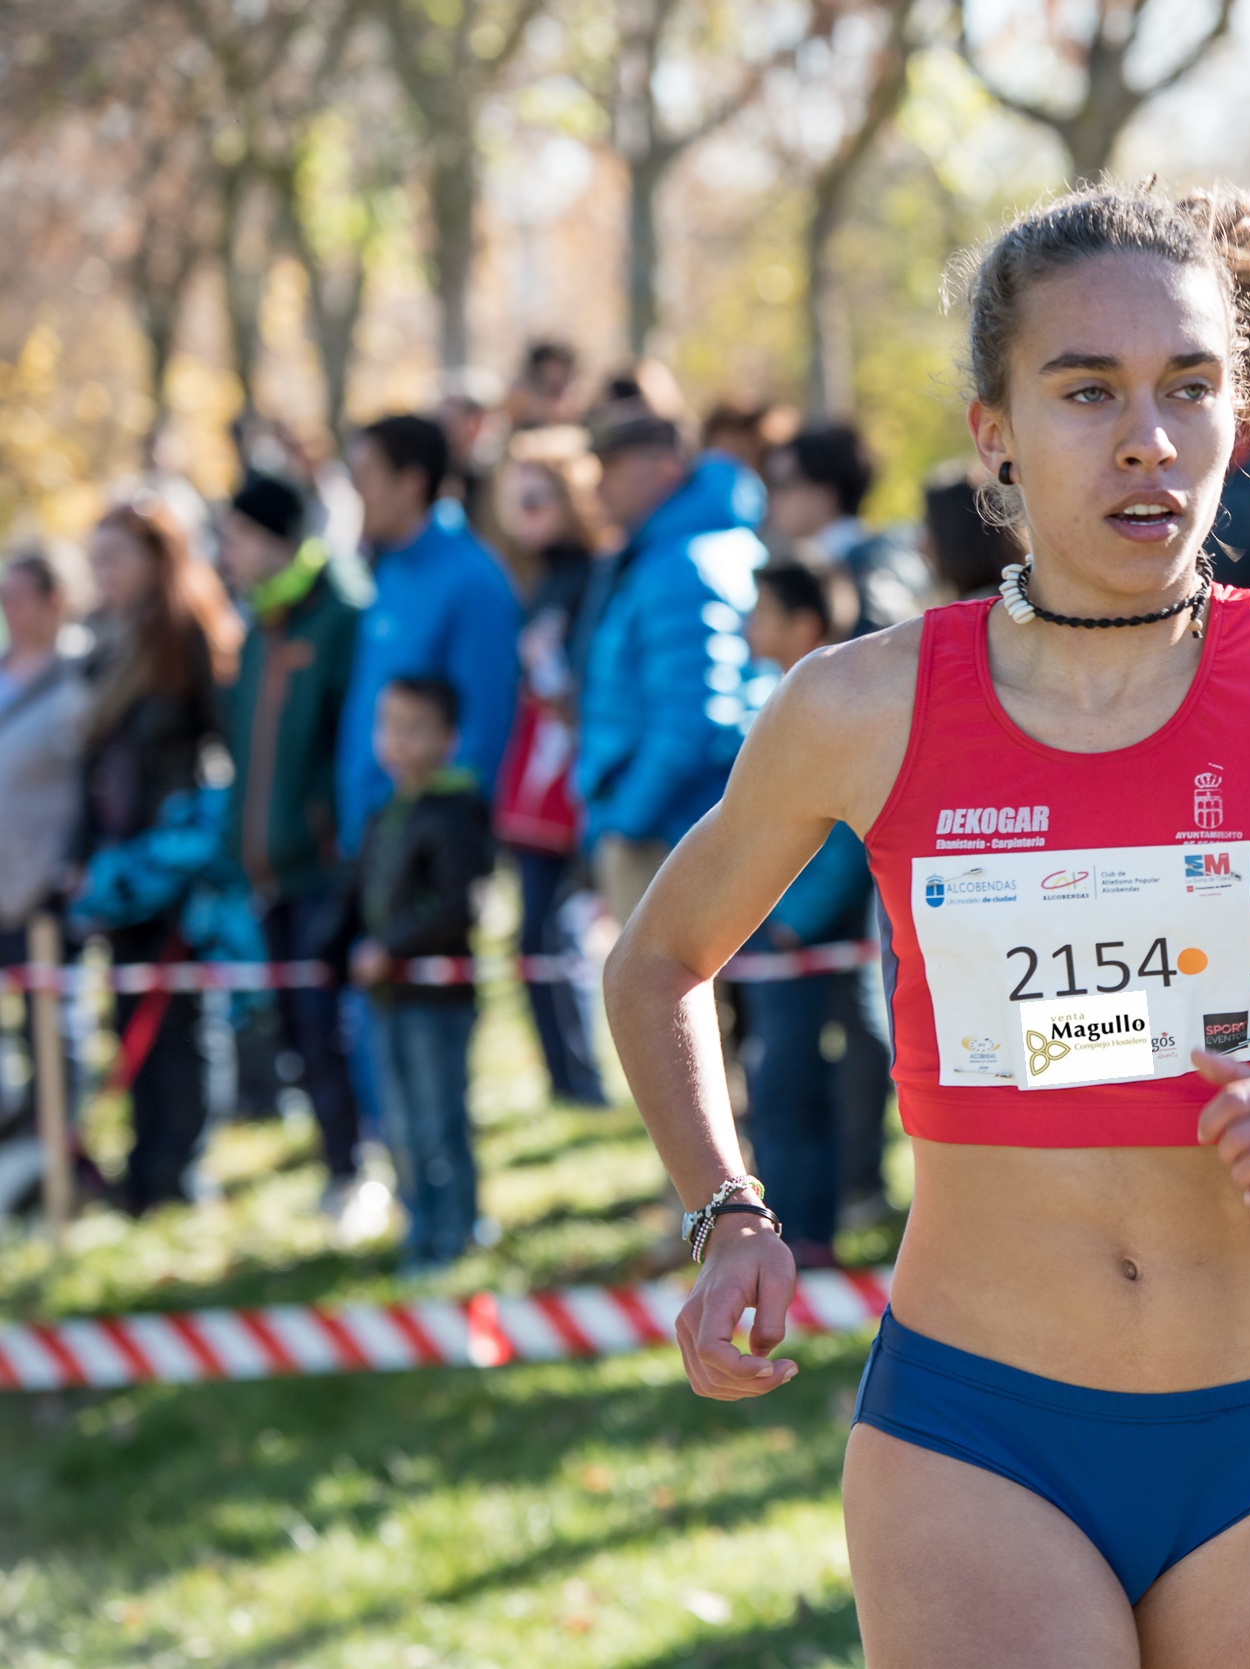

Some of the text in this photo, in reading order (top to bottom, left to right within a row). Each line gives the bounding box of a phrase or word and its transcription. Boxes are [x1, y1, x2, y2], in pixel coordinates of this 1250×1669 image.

[936, 806, 1050, 835] DEKOGAR
[1175, 831, 1244, 839] AYUNTAMIENTO
[946, 880, 1017, 894] ALCOBENDAS
[992, 895, 1017, 903] ciudad
[1043, 893, 1089, 901] ALCOBENDAS
[1006, 937, 1177, 1001] 2154
[1205, 1021, 1247, 1036] SPORT
[1206, 1030, 1247, 1045] EVENTOS
